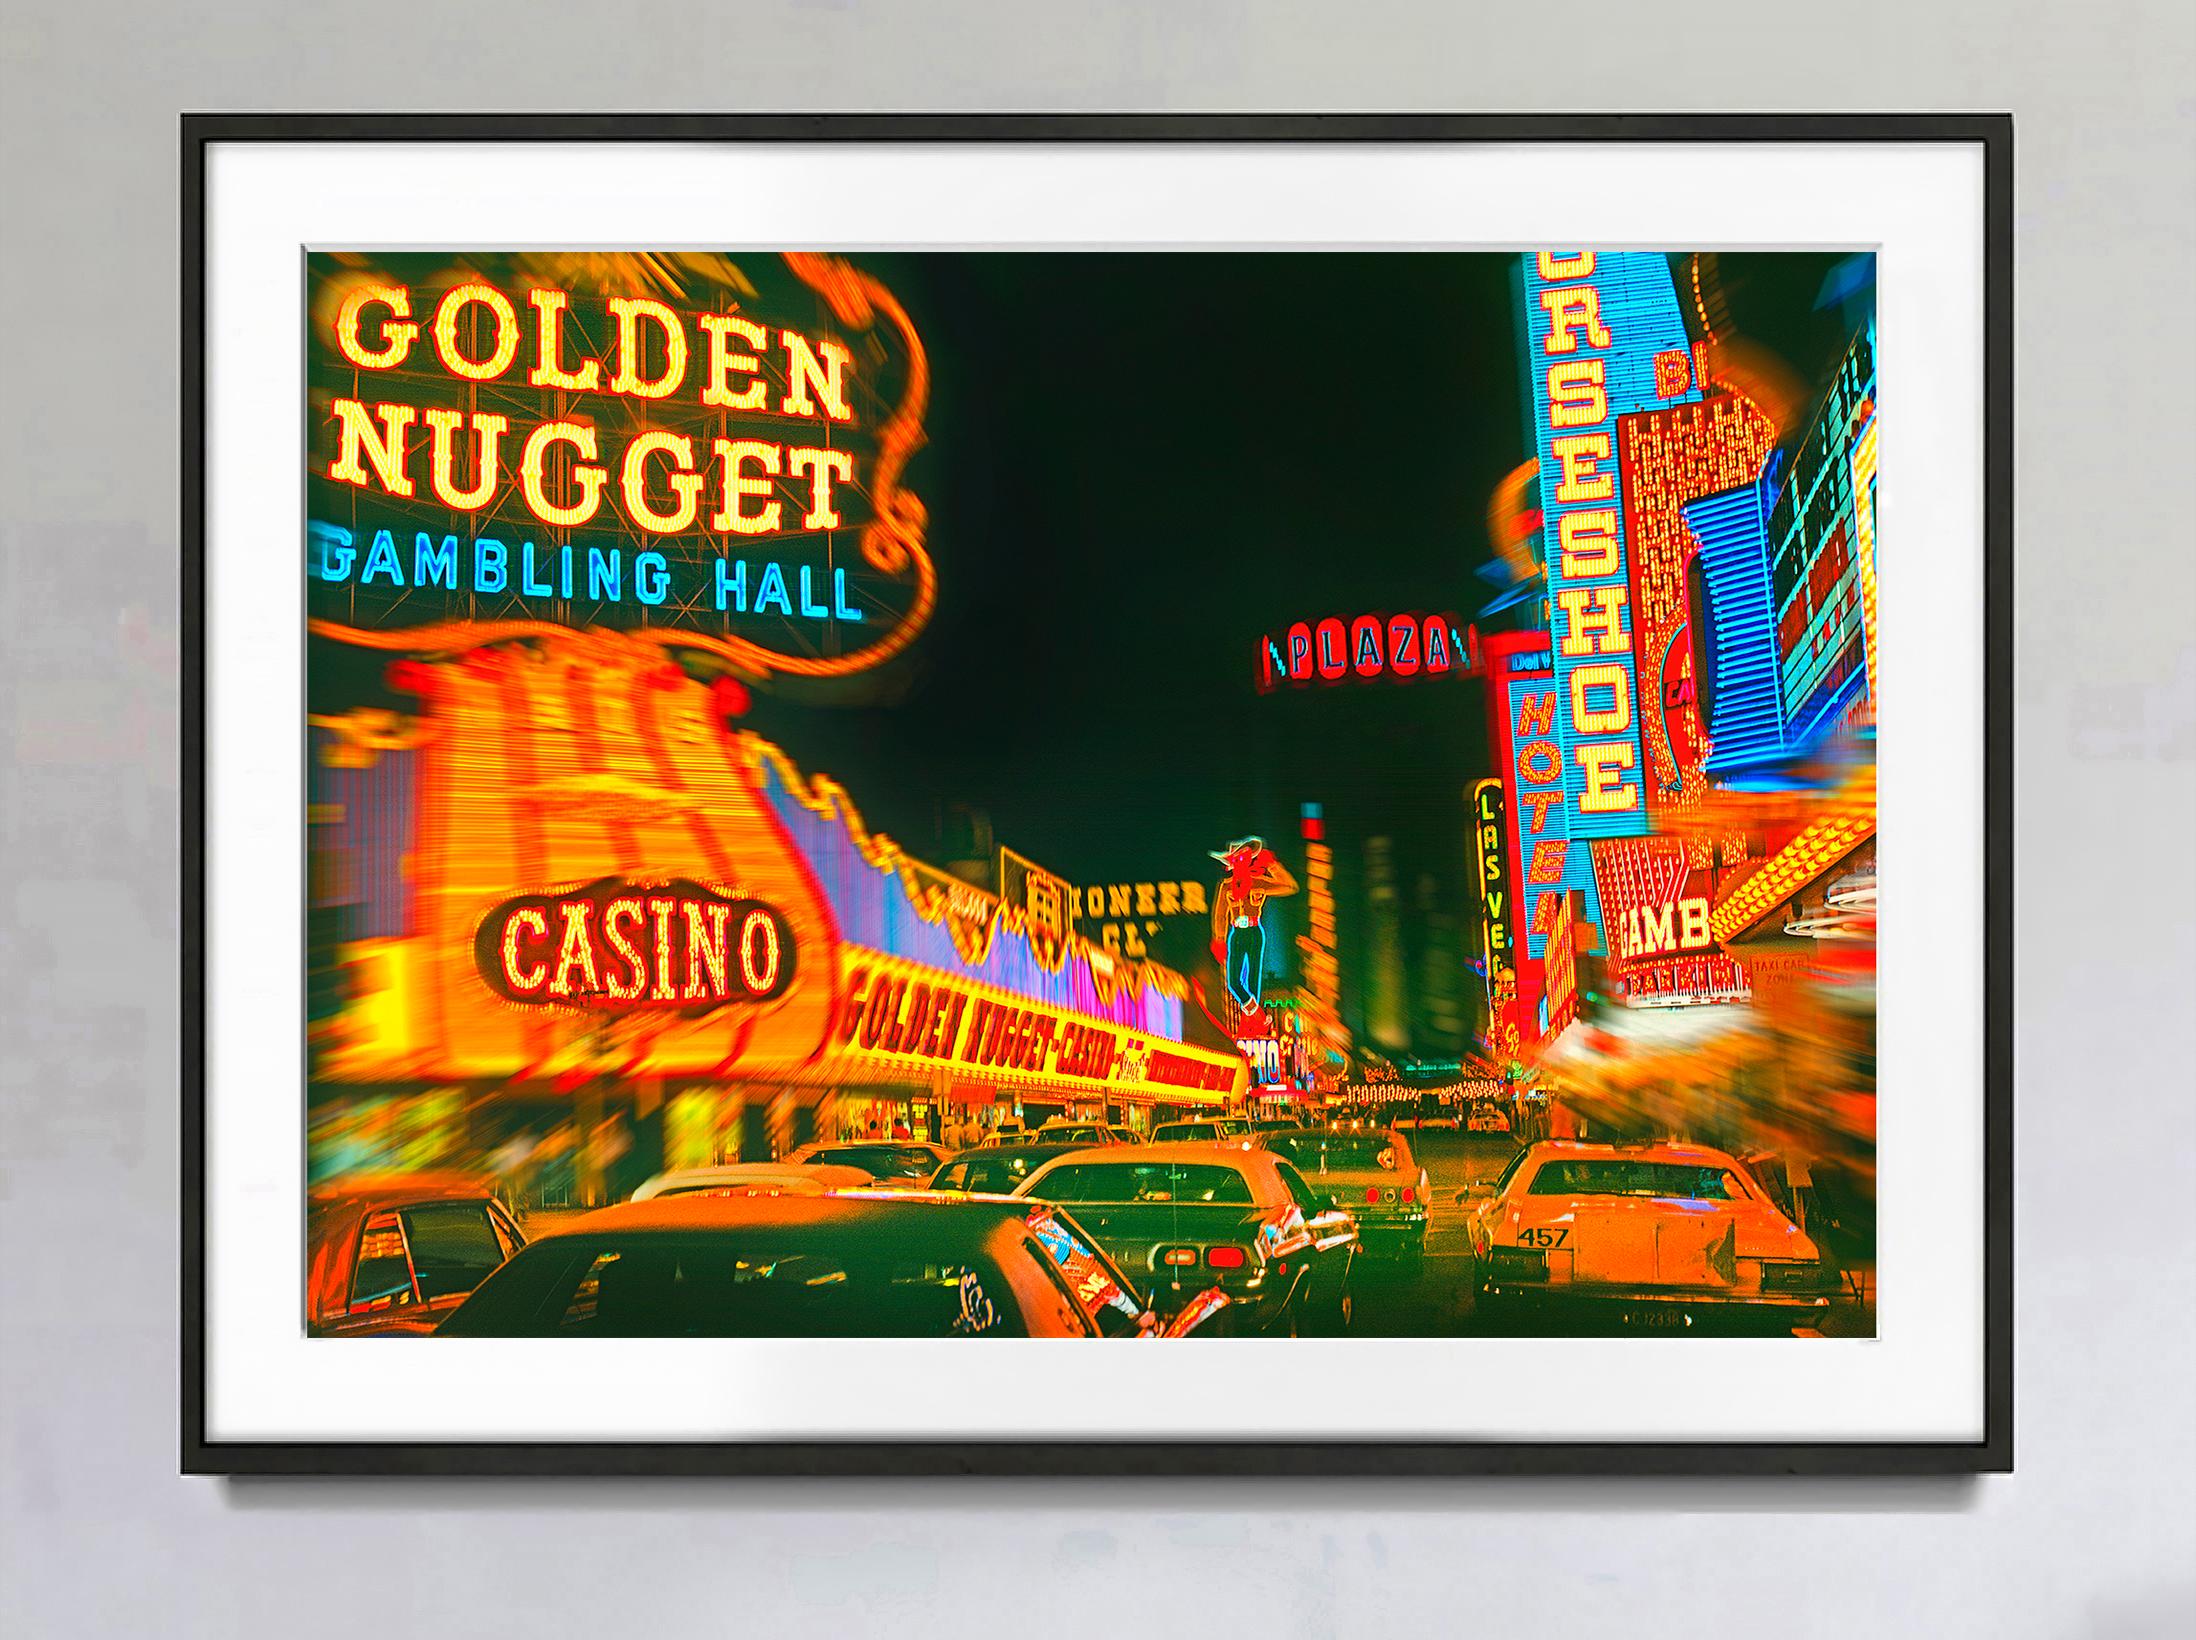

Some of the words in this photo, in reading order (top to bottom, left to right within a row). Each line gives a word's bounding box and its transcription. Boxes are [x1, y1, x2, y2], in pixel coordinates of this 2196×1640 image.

[333, 284, 856, 422] GOLDEN
[328, 397, 856, 536] NUGGET
[315, 523, 671, 606] GAMBLING
[715, 559, 863, 621] HALL
[1291, 626, 1449, 674] PLAZA
[500, 895, 782, 1001] CASINO
[1072, 881, 1208, 917] IONEER
[1518, 1228, 1569, 1247] 457
